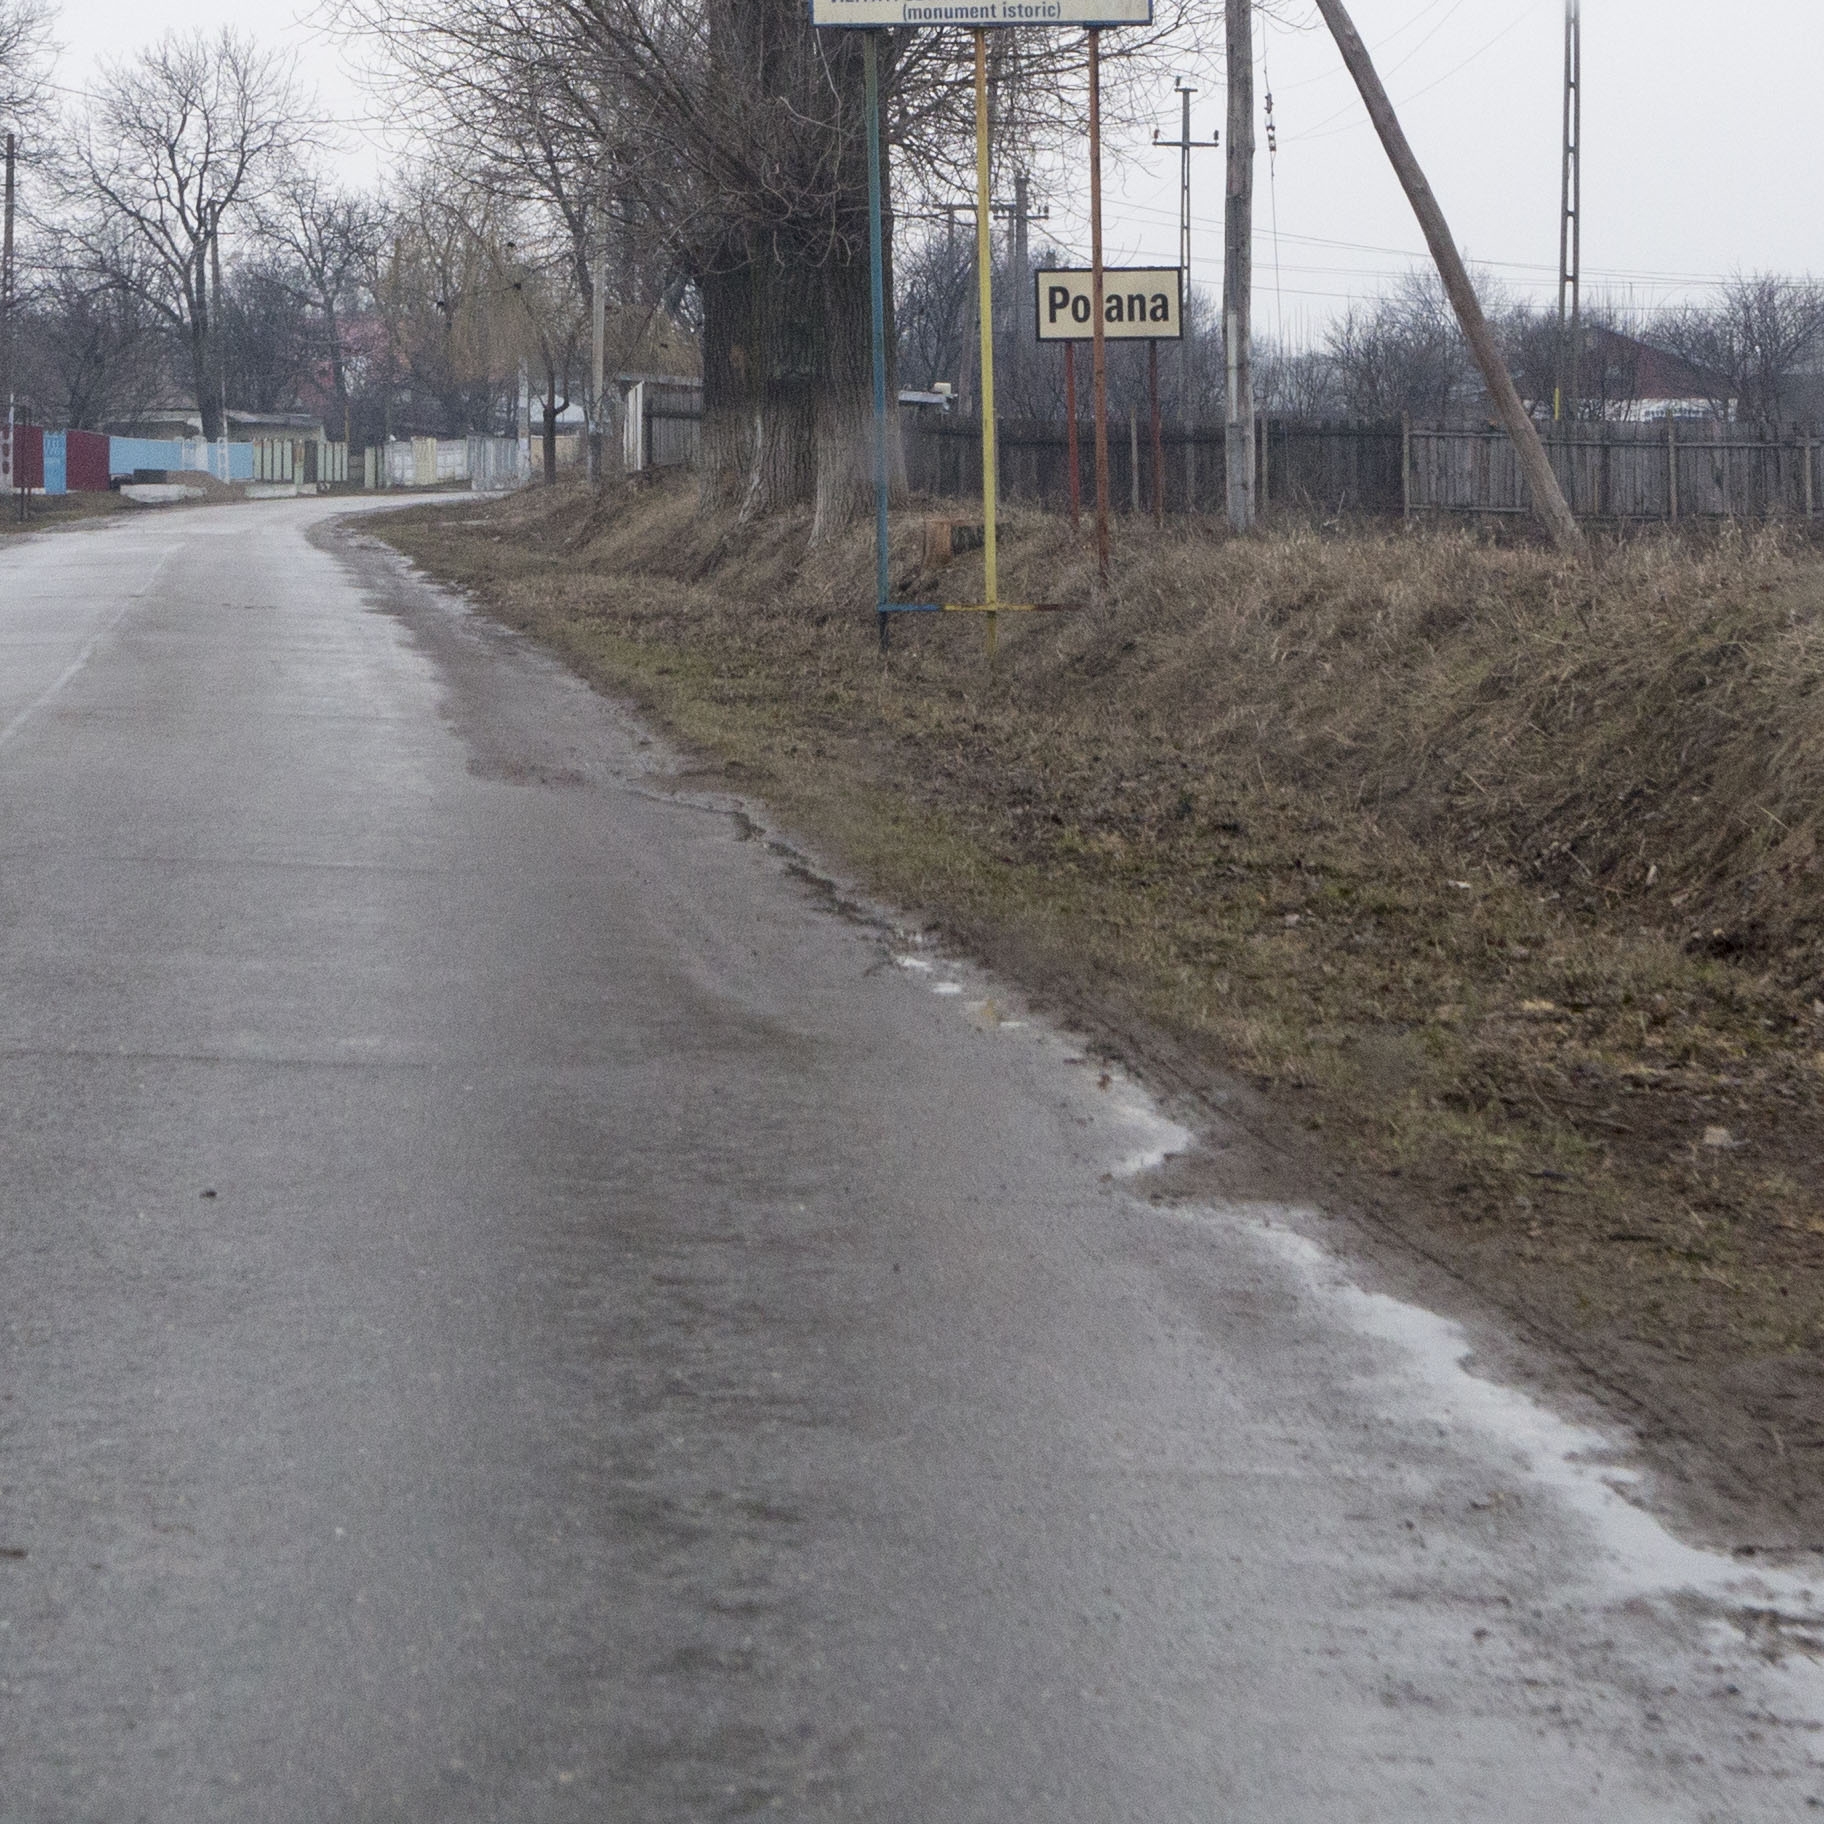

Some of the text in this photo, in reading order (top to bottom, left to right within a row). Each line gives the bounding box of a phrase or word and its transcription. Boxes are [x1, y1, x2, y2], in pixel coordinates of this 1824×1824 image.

[902, 1, 1061, 21] (monument istoric)
[1048, 285, 1170, 323] Poana
